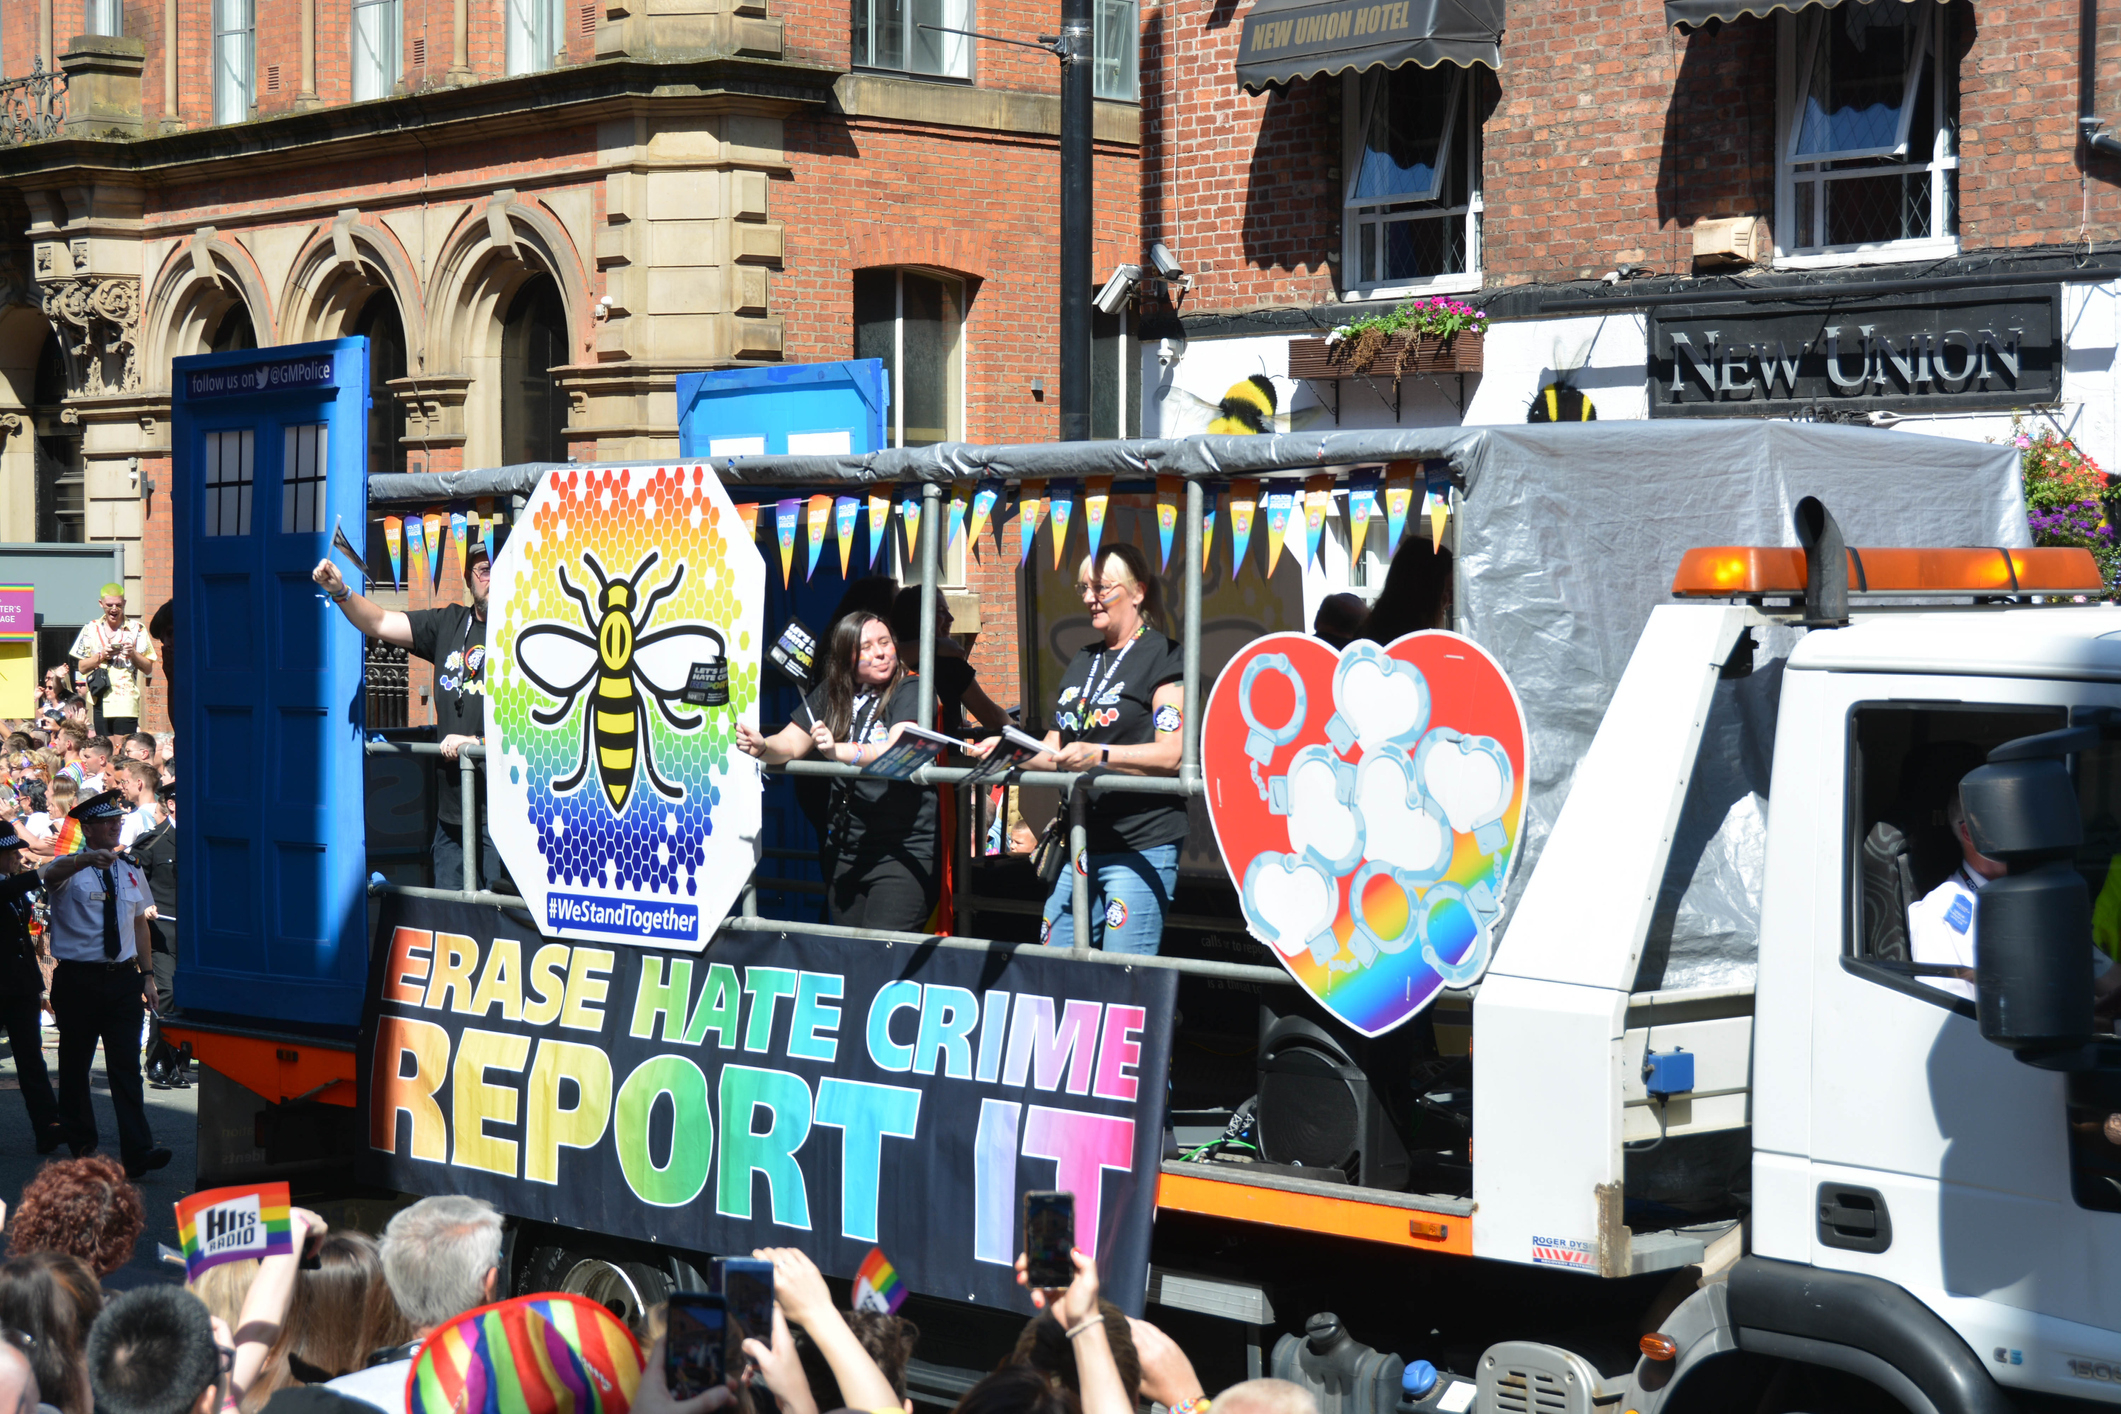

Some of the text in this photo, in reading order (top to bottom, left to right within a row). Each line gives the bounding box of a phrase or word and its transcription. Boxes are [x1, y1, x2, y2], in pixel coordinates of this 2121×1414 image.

[1251, 1, 1410, 52] NEW UNION HOTEL
[192, 361, 330, 393] follow us on @GMPolice
[549, 897, 696, 935] #WeStandTogether
[381, 925, 1146, 1103] ERASE HATE CRIME
[370, 1014, 1136, 1267] REPORT IT
[209, 1226, 255, 1253] RADIO
[1532, 1235, 1567, 1247] ROGER
